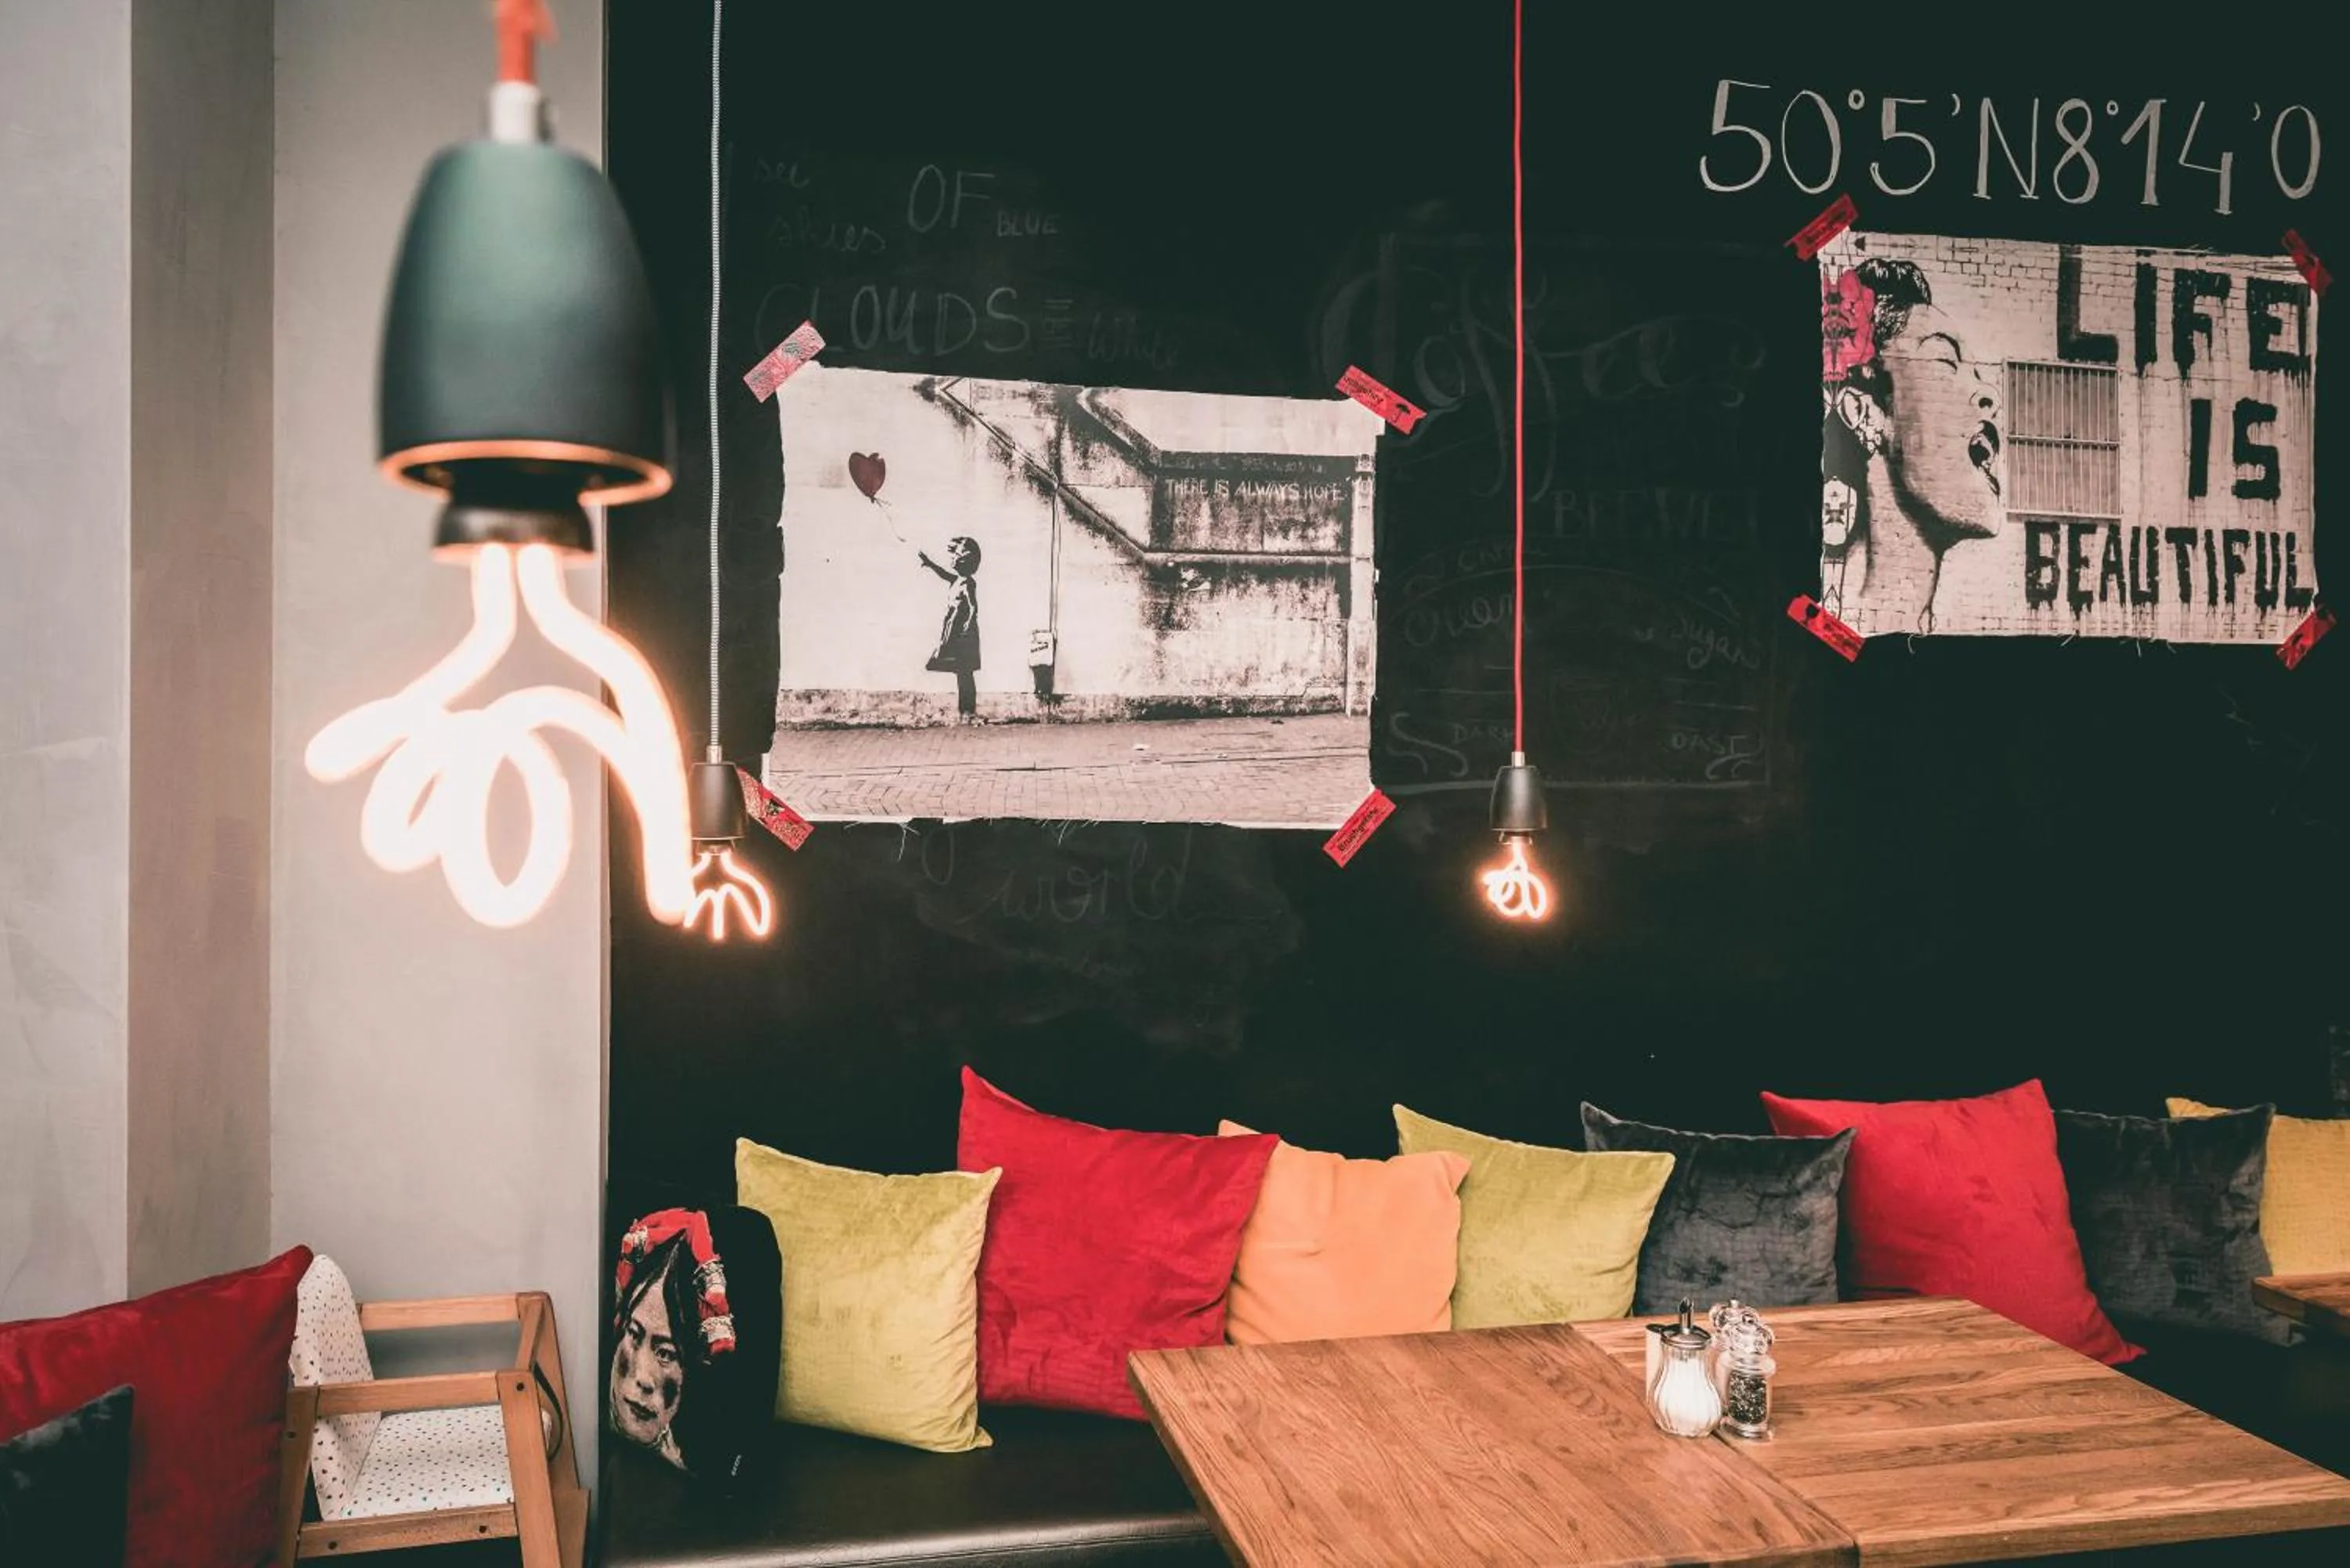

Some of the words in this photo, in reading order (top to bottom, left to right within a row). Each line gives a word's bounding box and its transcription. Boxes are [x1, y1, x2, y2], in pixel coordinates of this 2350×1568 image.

[907, 163, 996, 233] OF
[996, 210, 1061, 237] BLUE
[2056, 244, 2312, 378] LIFE
[1165, 477, 1208, 497] THERE
[1213, 479, 1230, 497] IS
[1235, 480, 1300, 500] ALWAYS
[2188, 398, 2281, 502] IS
[2025, 520, 2316, 619] BEAUTIFUL
